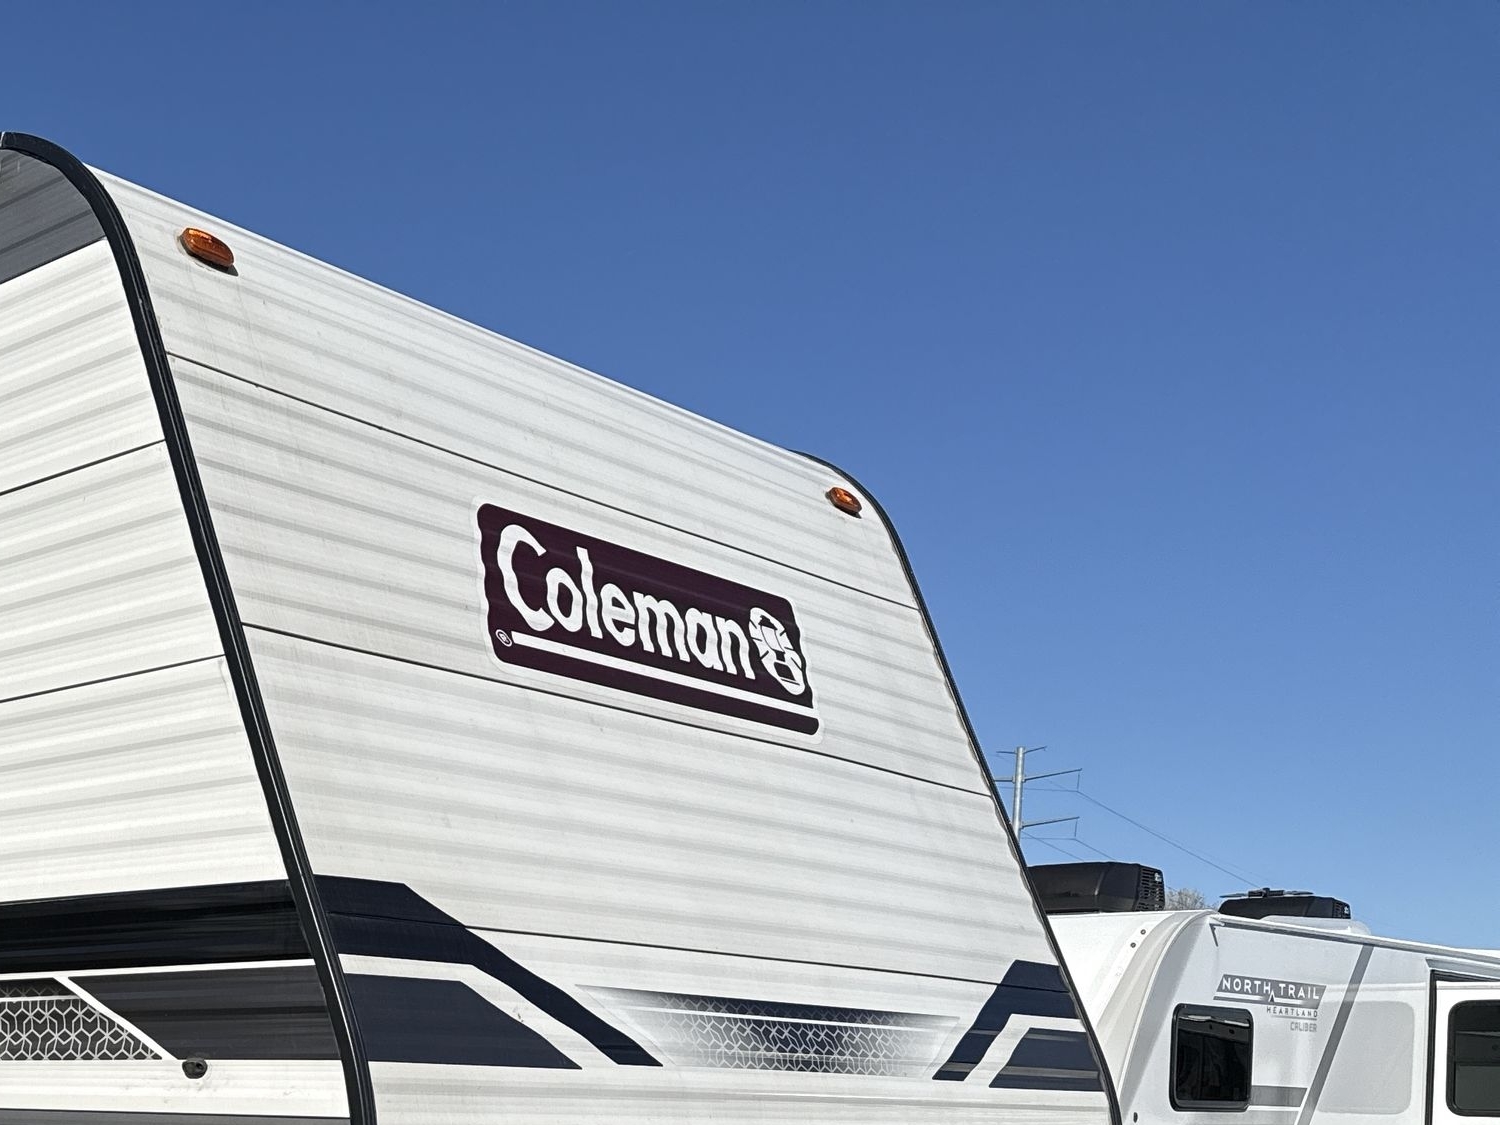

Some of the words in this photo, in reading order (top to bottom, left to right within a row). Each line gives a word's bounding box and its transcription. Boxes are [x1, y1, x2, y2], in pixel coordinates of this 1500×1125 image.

[496, 523, 756, 680] Coleman
[1221, 977, 1272, 995] NORTH
[1278, 983, 1320, 1000] TRAIL
[1266, 1005, 1318, 1018] HEARTLAND
[1290, 1021, 1318, 1033] CALIBER
